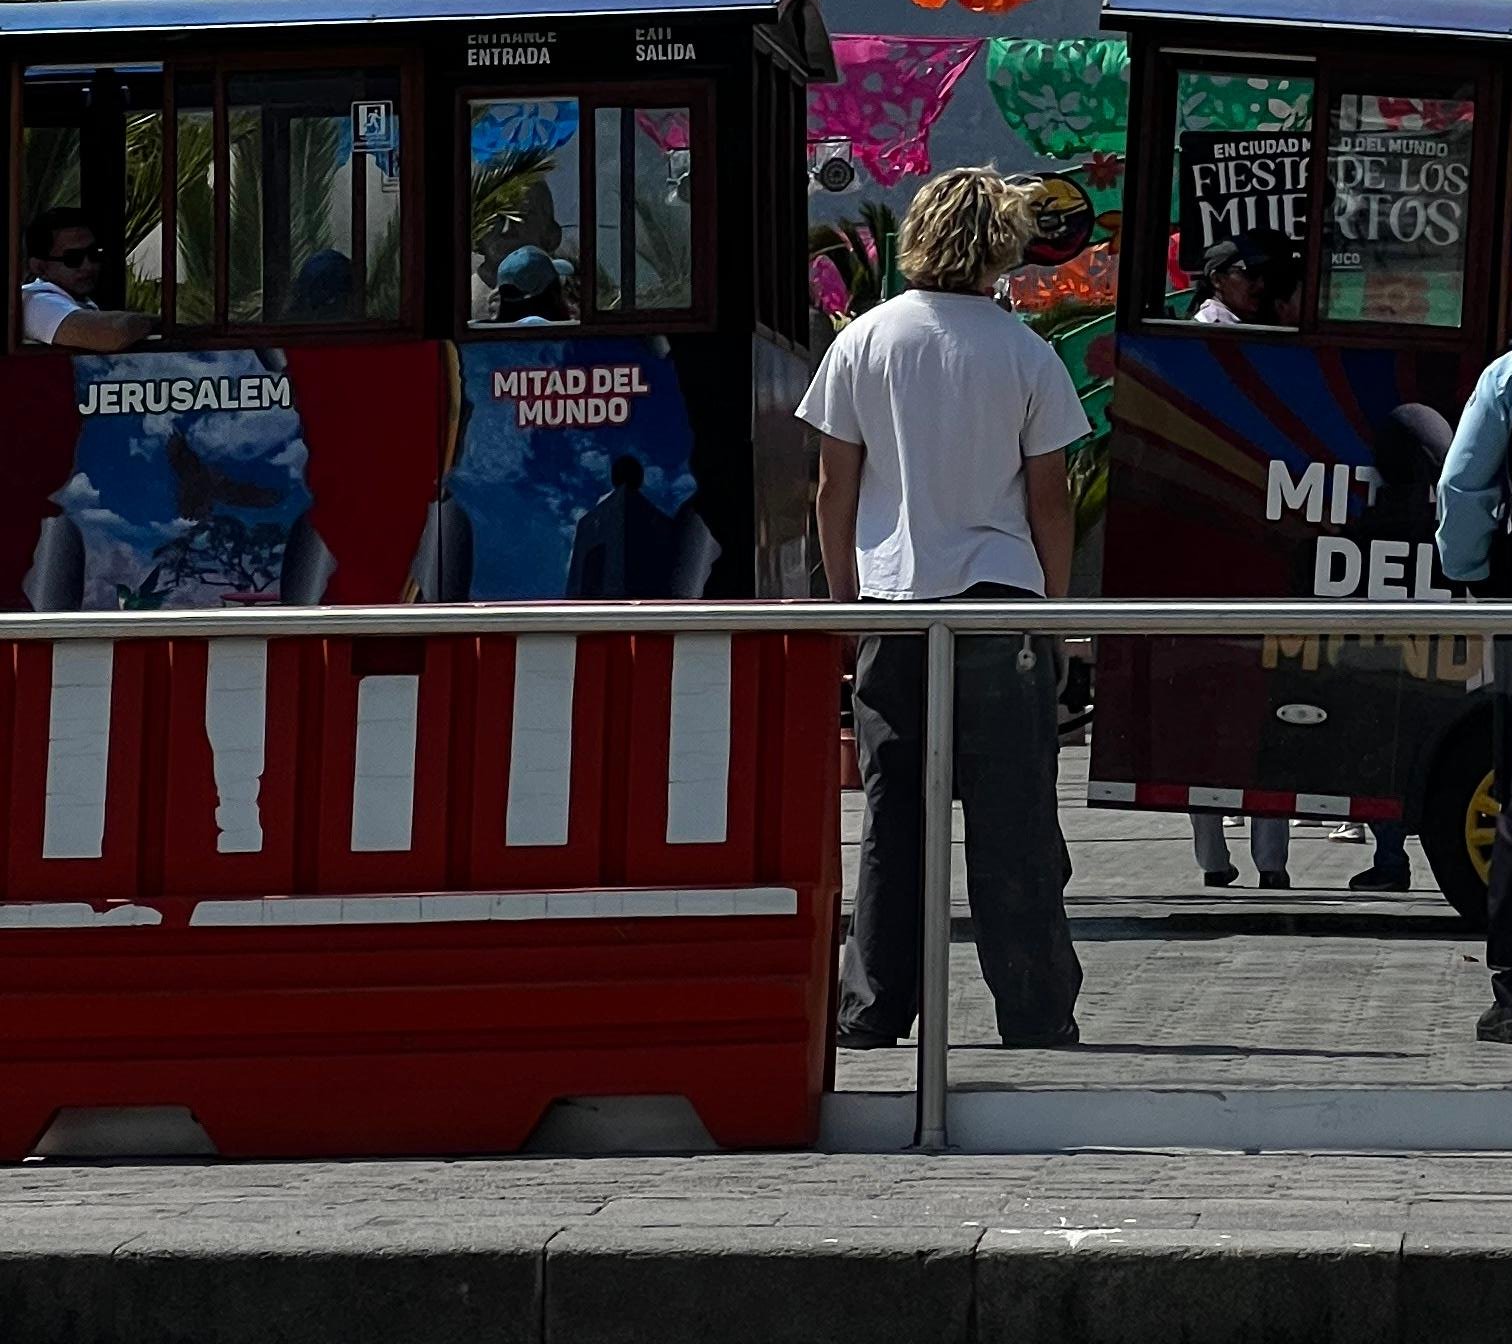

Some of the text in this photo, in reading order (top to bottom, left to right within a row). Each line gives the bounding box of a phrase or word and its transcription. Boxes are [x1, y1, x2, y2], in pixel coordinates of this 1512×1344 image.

[467, 47, 551, 66] ENTRADA
[635, 43, 697, 61] SALIDA
[1213, 142, 1237, 159] EN
[1238, 139, 1300, 156] CIUDAD
[1355, 137, 1386, 153] DEL
[1388, 138, 1449, 157] MUNDO
[1330, 156, 1387, 190] DE
[1400, 158, 1469, 195] LOS
[78, 376, 291, 415] JERUSALEM
[494, 367, 648, 397] MITAD DEL
[518, 397, 628, 426] MUNDO
[1266, 460, 1385, 525] MIT
[1314, 535, 1452, 601] DEL
